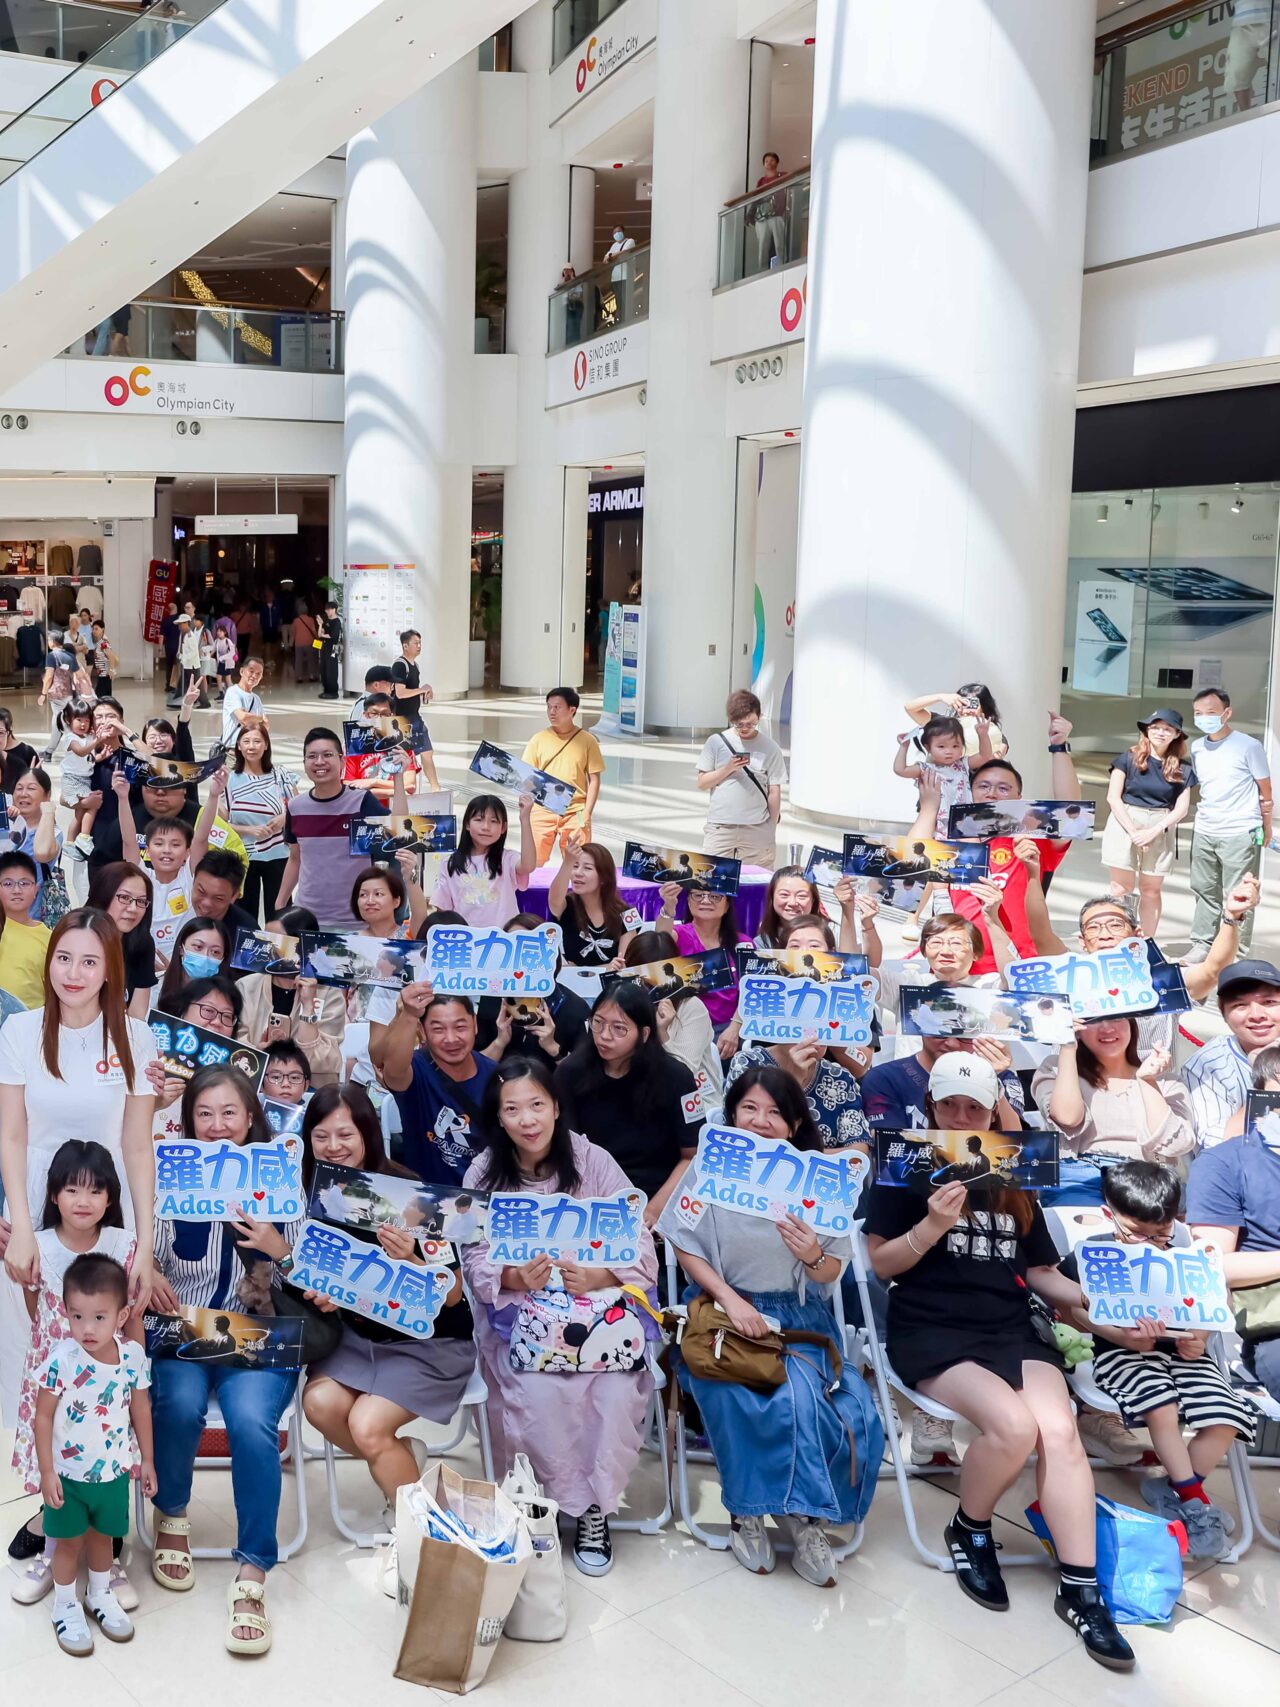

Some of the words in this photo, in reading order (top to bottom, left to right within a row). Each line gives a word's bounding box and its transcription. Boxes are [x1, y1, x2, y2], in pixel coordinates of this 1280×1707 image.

[625, 35, 639, 53] City
[576, 37, 597, 93] OC
[1123, 64, 1191, 111] KEND
[1198, 49, 1228, 82] PO
[588, 345, 604, 363] SINO
[604, 337, 627, 357] GROUP
[104, 366, 151, 406] OC
[157, 381, 187, 394] 奧海城
[157, 396, 211, 412] Olympian
[213, 398, 235, 413] City
[602, 487, 644, 511] ARMOU
[155, 568, 170, 578] GU
[360, 753, 384, 769] CHAMP
[209, 829, 226, 839] OC
[623, 908, 639, 924] OC
[156, 925, 173, 939] OC
[431, 928, 557, 972] 羅力威
[1009, 948, 1151, 993] 羅力威
[523, 974, 551, 993] Lo
[743, 978, 871, 1024] 羅力威
[1123, 988, 1153, 1008] Lo
[840, 1022, 868, 1042] Lo
[685, 1092, 701, 1112] OC
[887, 1142, 933, 1164] 羅力威
[156, 1143, 300, 1192] 羅力威
[701, 1128, 858, 1209] 羅力威
[268, 1196, 298, 1215] Lo
[681, 1195, 704, 1216] OC
[491, 1197, 640, 1242] 羅力威
[814, 1206, 849, 1231] Lo
[603, 1245, 635, 1262] Lo
[297, 1224, 443, 1317] 羅力威
[1082, 1245, 1222, 1297] 羅力威
[398, 1309, 428, 1334] Lo
[1197, 1302, 1228, 1323] Lo
[143, 1315, 183, 1338] 羅力威
